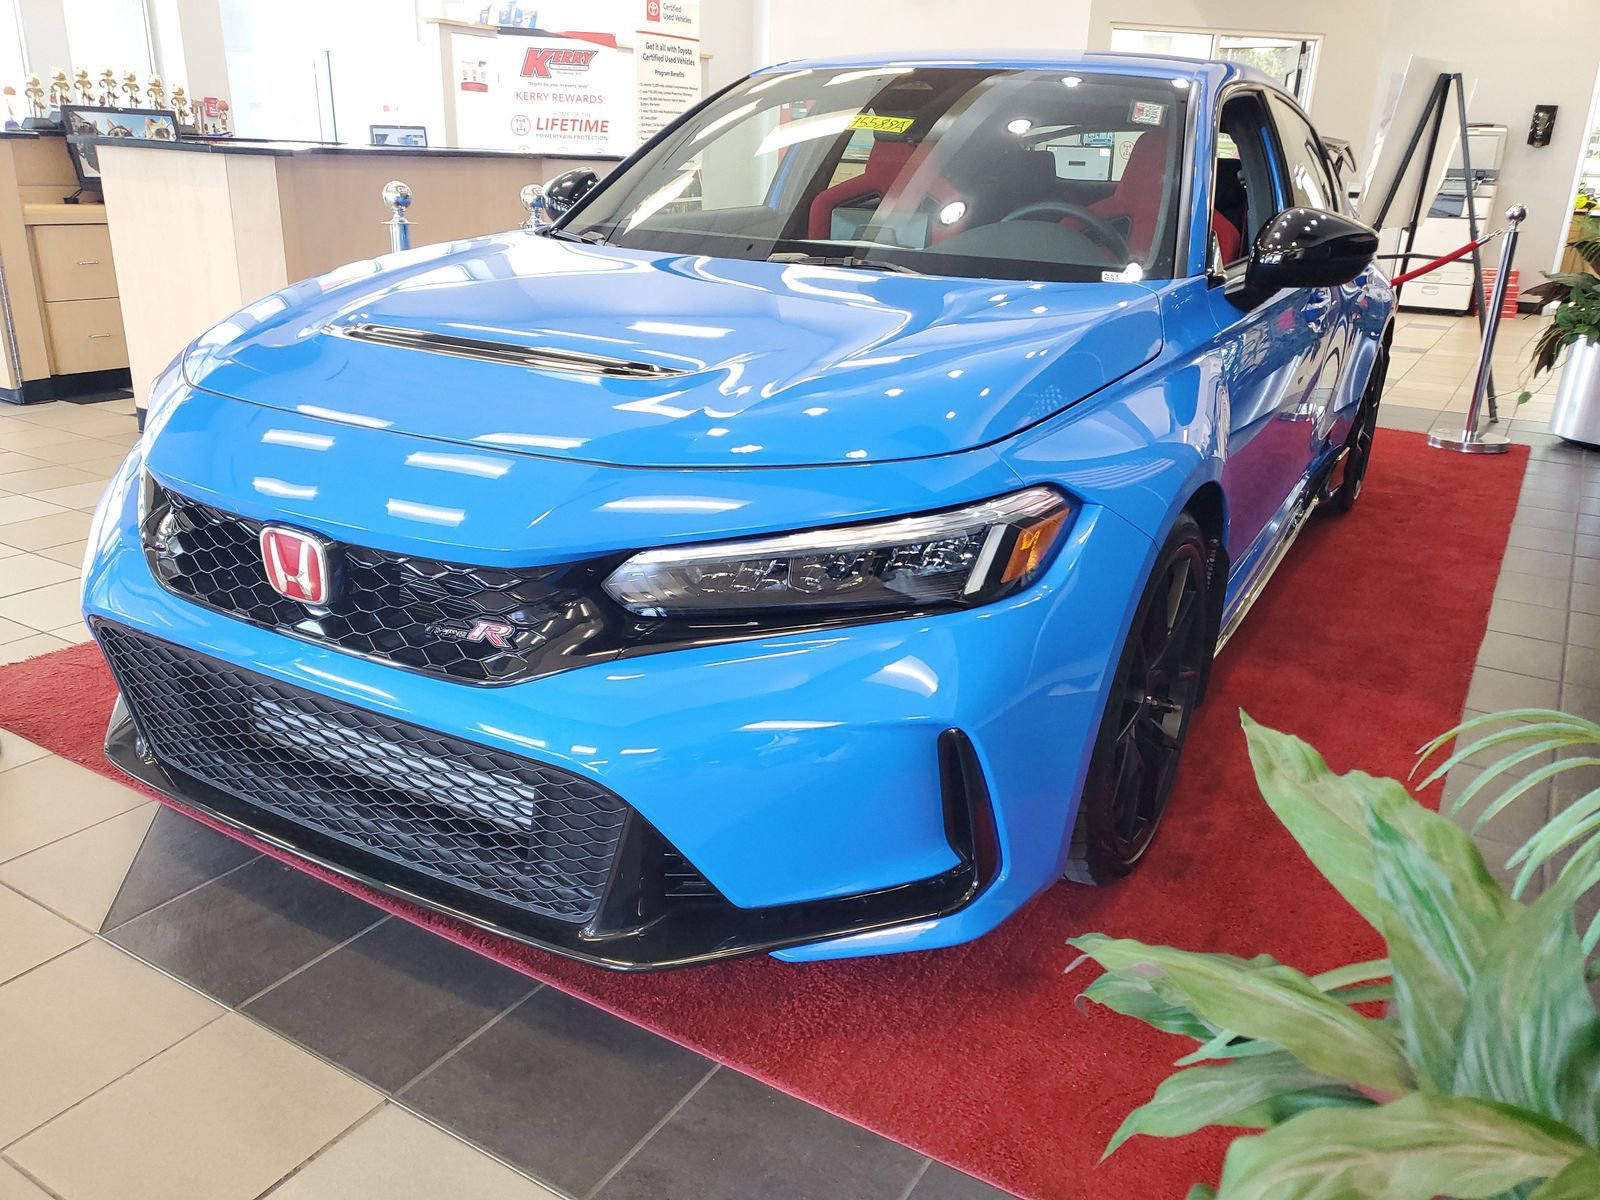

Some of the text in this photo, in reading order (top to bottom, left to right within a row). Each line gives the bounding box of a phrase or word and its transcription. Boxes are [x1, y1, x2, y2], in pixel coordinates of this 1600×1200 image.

[663, 2, 682, 13] Certified
[663, 12, 692, 24] Used Vehicles
[645, 41, 655, 51] Get
[667, 45, 677, 53] with
[677, 45, 693, 56] Toyota
[520, 47, 599, 79] KERRY
[642, 52, 696, 66] Certified Used Vehicles
[654, 69, 685, 78] Program Benefits
[515, 91, 604, 104] KERRY REWARDS
[536, 117, 610, 133] LIFETIME
[467, 620, 516, 649] R
